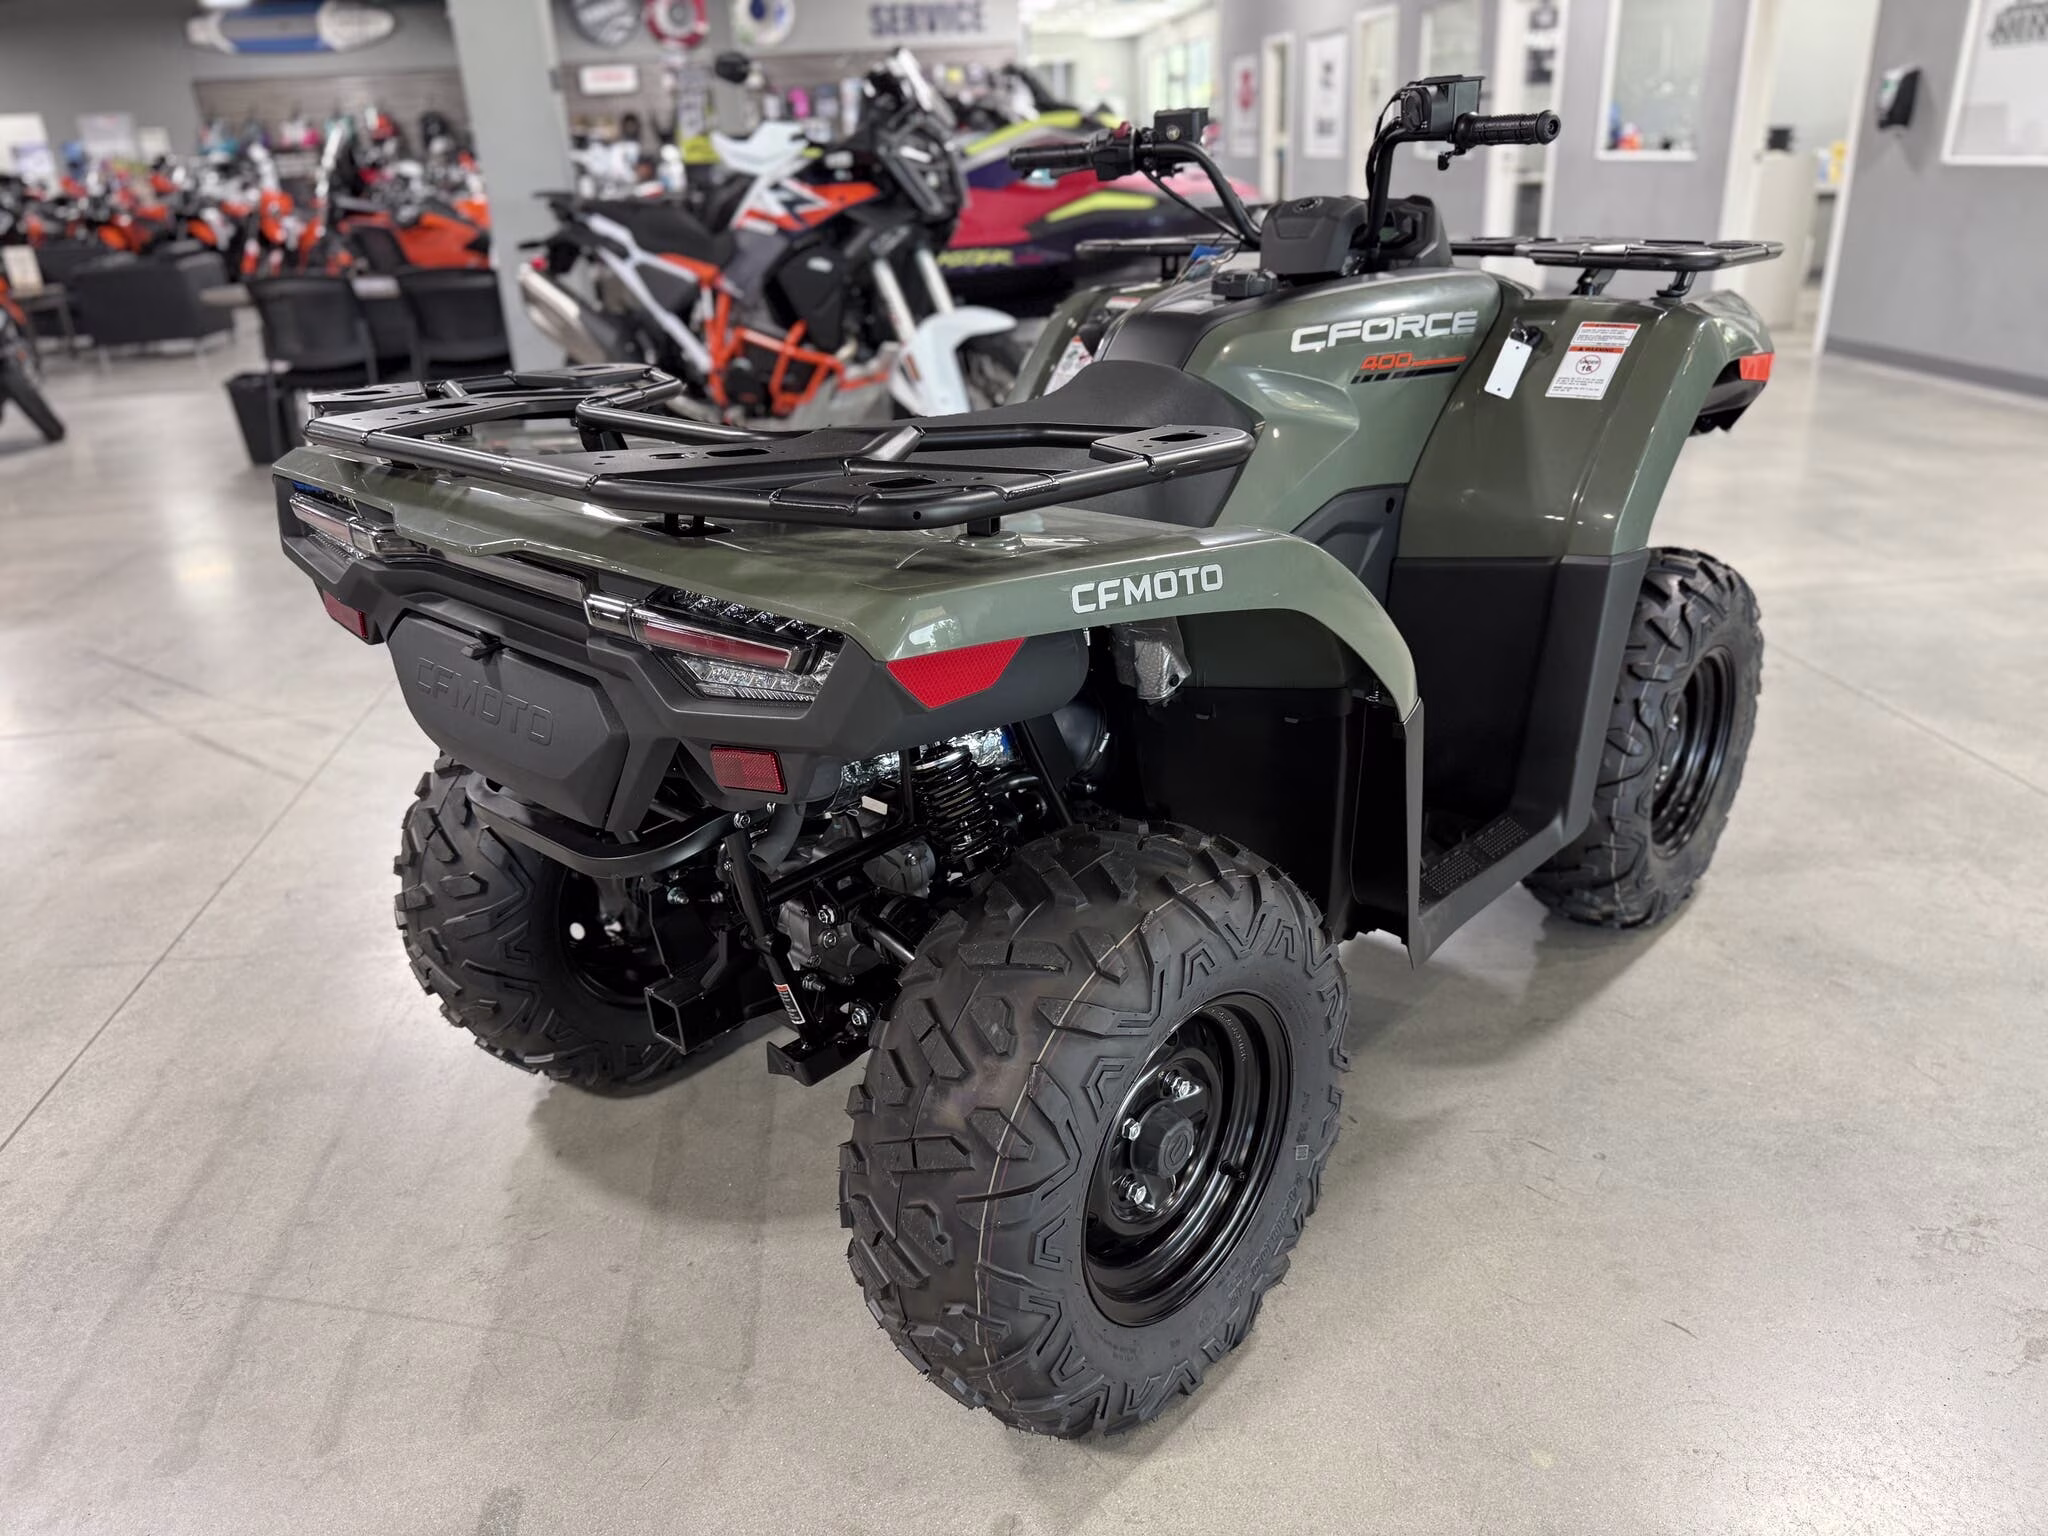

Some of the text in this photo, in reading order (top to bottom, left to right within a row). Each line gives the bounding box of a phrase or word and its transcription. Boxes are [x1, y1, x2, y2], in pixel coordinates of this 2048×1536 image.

[869, 1, 985, 37] SERVICE
[1290, 310, 1479, 353] CFORCE
[1360, 352, 1414, 371] 400
[1071, 563, 1223, 614] CFMOTO
[416, 657, 554, 746] CFMOTO
